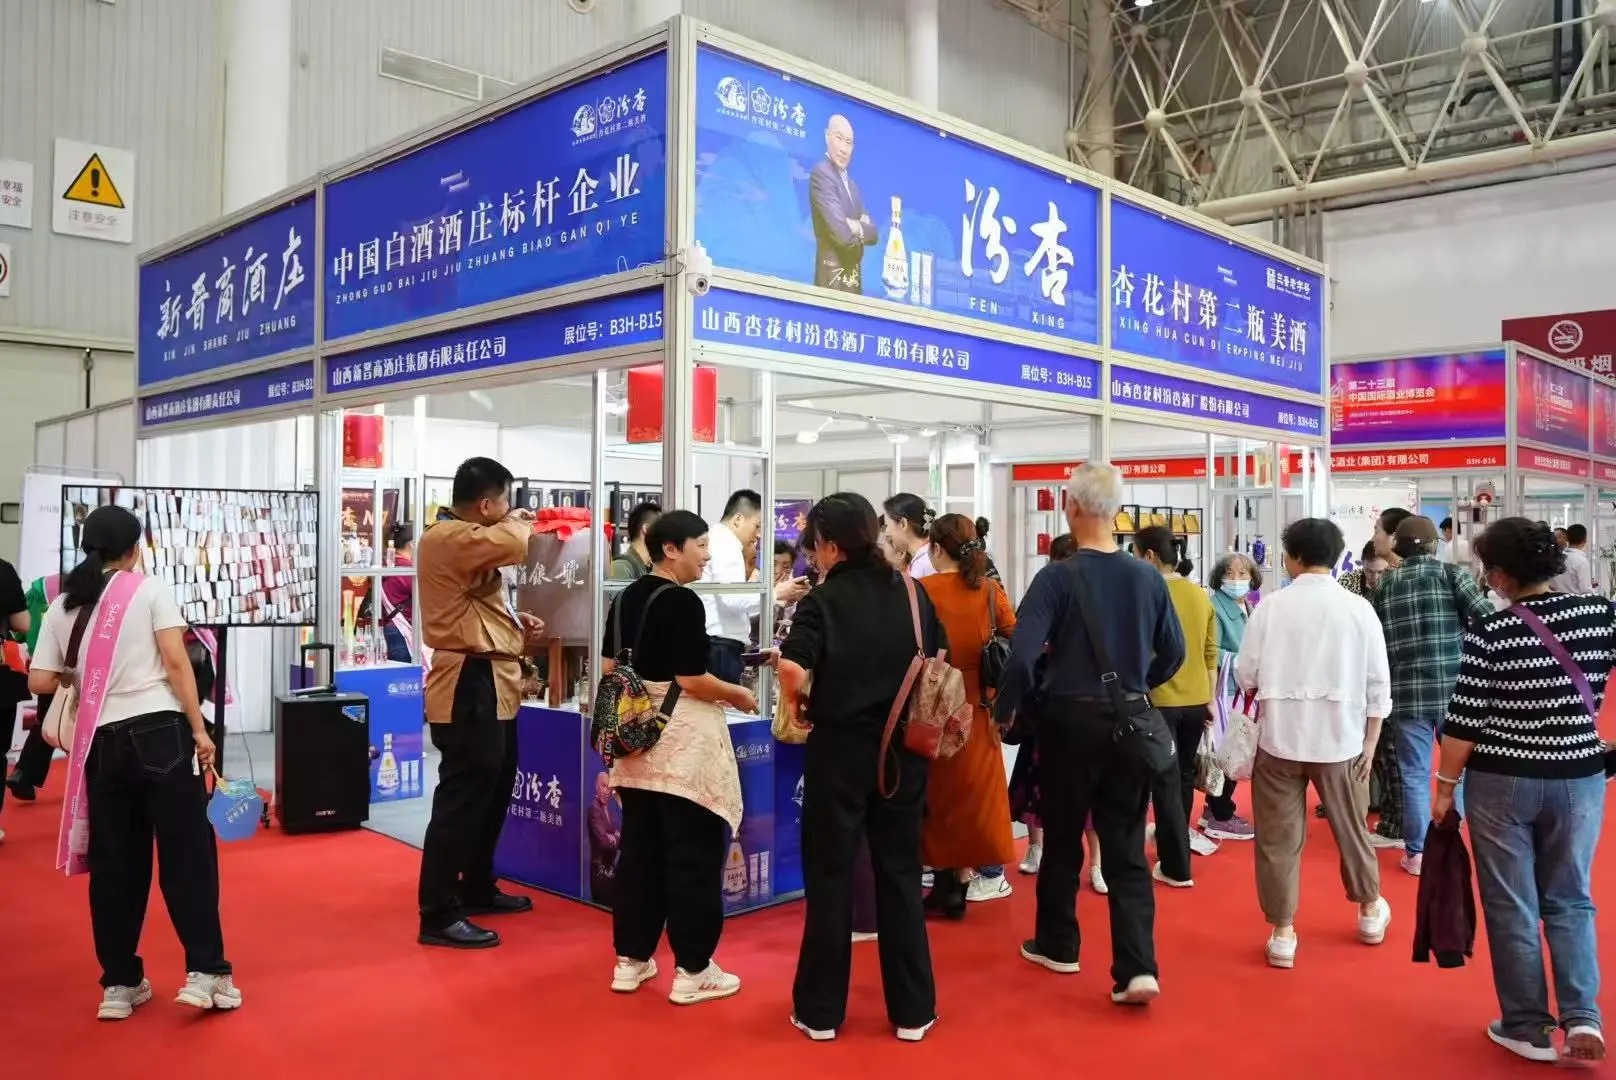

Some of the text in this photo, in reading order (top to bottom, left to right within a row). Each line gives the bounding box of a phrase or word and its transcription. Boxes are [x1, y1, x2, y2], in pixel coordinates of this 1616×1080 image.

[617, 87, 647, 118] 汾杏
[333, 154, 641, 285] 中国白酒酒庄标杆企业
[961, 178, 1075, 306] 汾杏
[336, 212, 638, 304] ZHONG GUO BAI JIU JIU ZHUANG BIAO GAN QI YE
[970, 297, 1065, 329] FEN XING
[1111, 264, 1307, 355] 杏花村第二瓶美酒
[1120, 316, 1149, 334] XING
[1156, 325, 1177, 340] HUA
[1184, 332, 1205, 347] CUN
[163, 315, 297, 362] XIN JIN SHANG JIU ZHUANG
[332, 336, 506, 386] 山西新晋商酒庄集团有限责任公司
[702, 306, 970, 371] 山西杏花村汾杏酒厂股份有限公司
[526, 772, 562, 808] 汾杏
[507, 803, 563, 827] 花村第二瓶美酒
